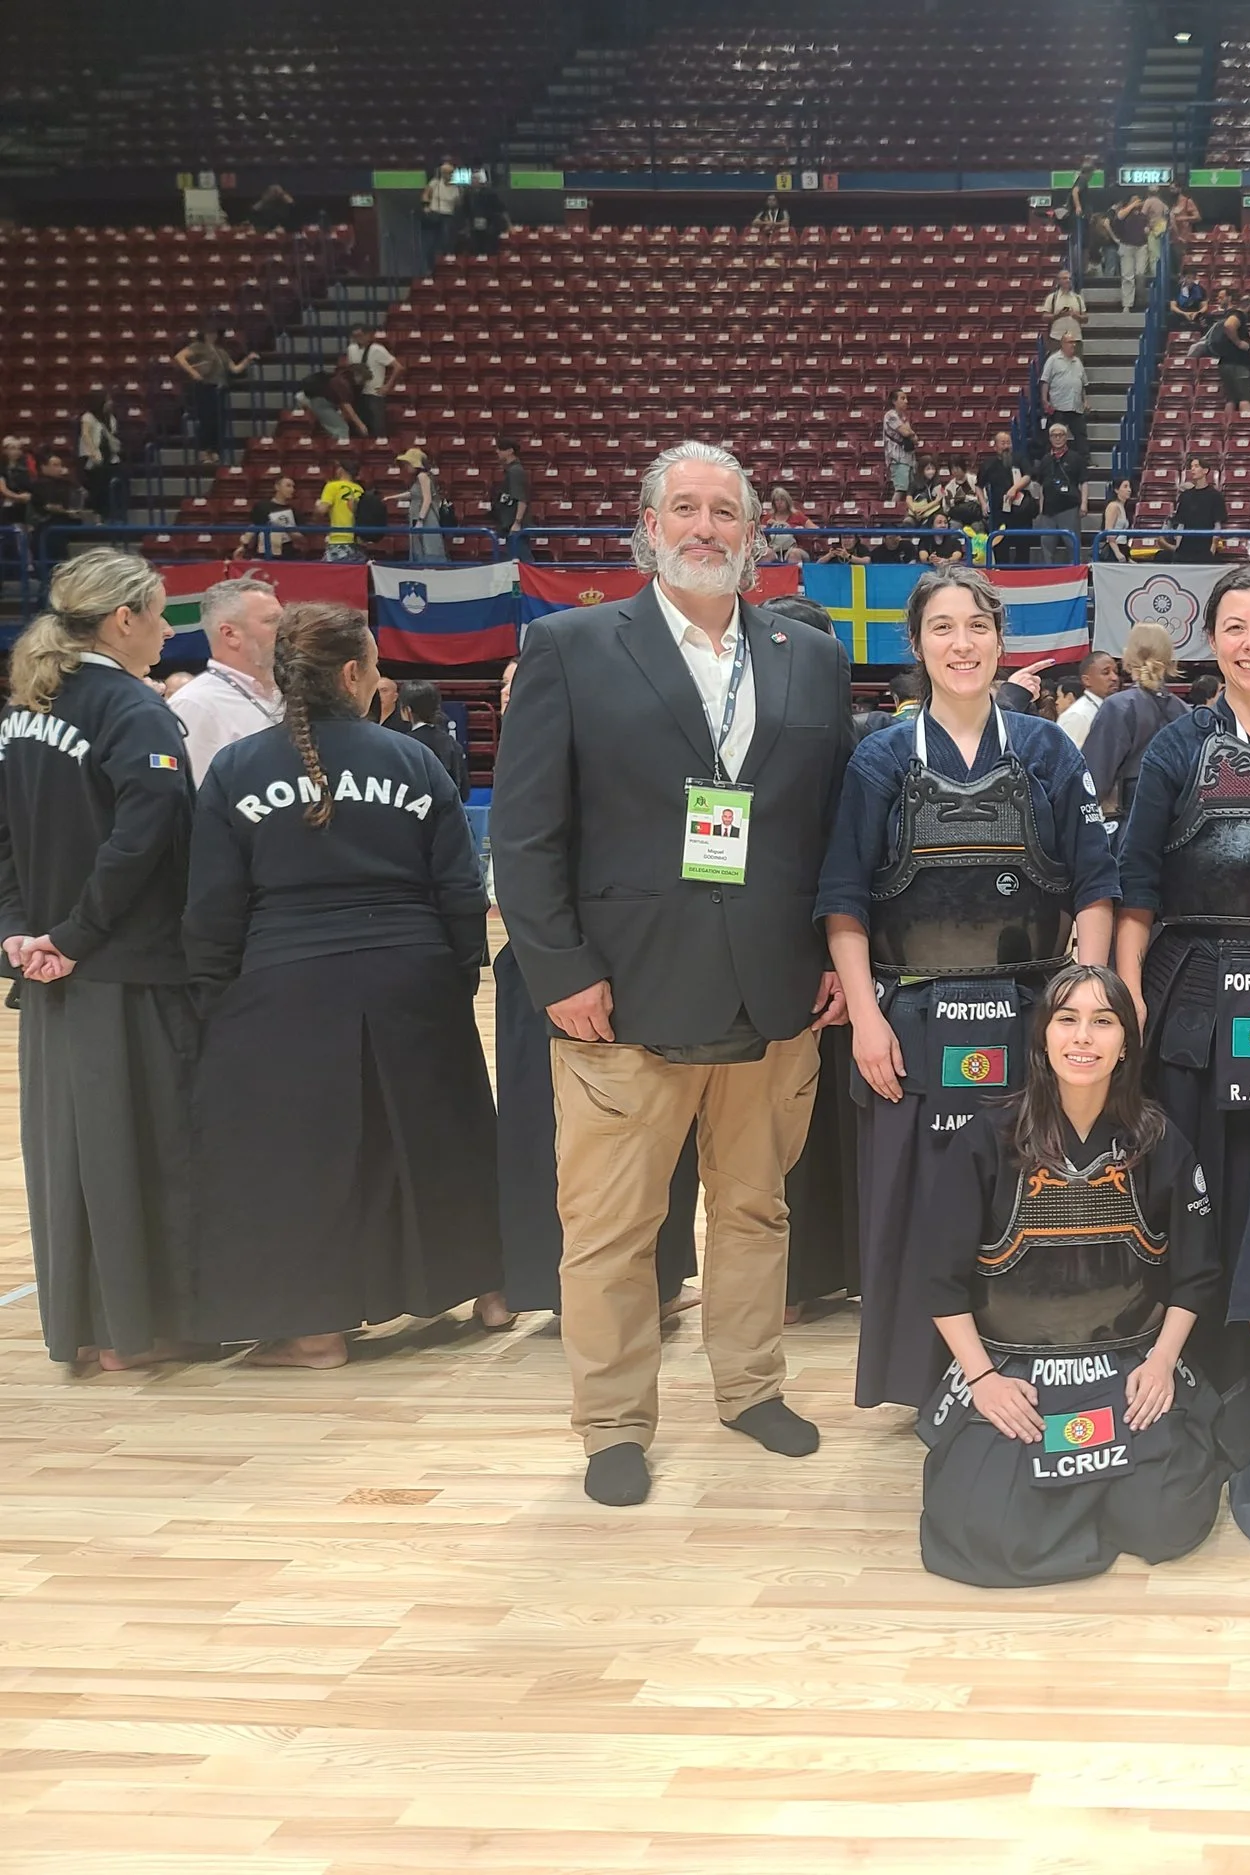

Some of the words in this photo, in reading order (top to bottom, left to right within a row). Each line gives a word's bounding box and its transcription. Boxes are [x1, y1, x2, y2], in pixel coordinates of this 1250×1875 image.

[1132, 170, 1160, 184] BAR
[236, 769, 432, 824] ROMÂNIA
[689, 866, 720, 875] DELEGATION
[936, 1000, 1017, 1021] PORTUGAL
[1031, 1354, 1118, 1387] PORTUGAL
[933, 1393, 955, 1426] 5
[1032, 1445, 1129, 1479] L.CRUZ
